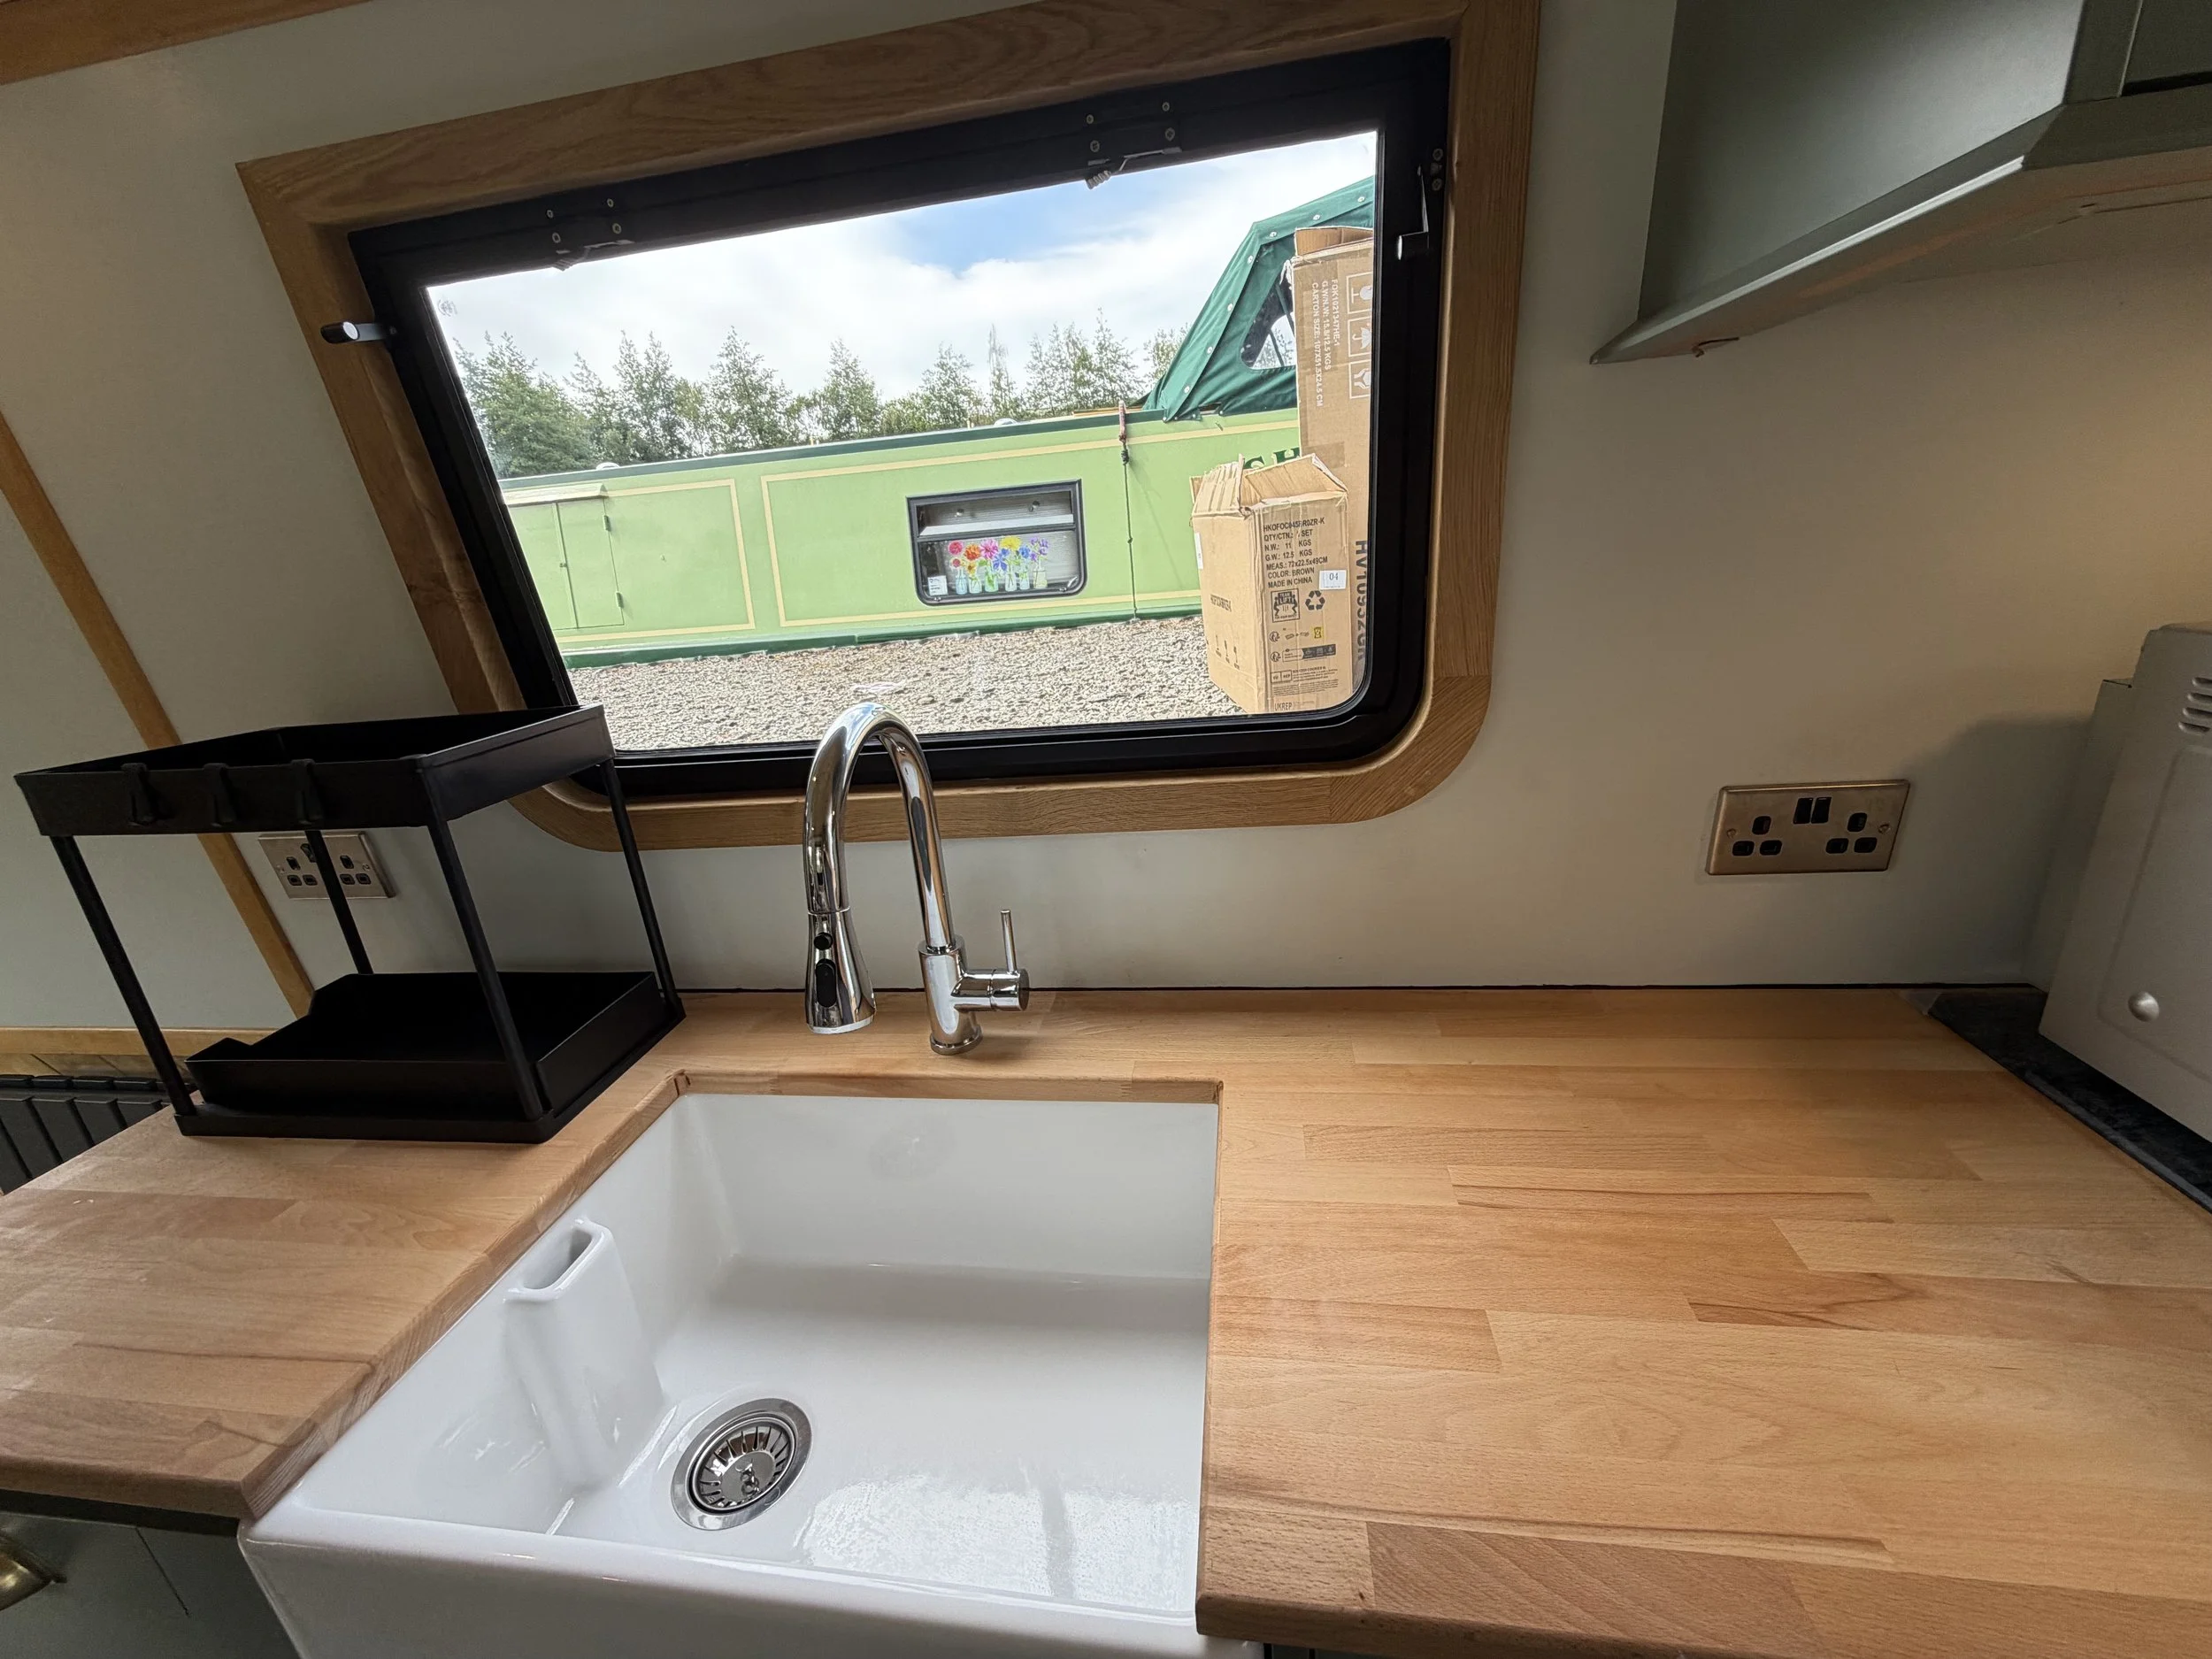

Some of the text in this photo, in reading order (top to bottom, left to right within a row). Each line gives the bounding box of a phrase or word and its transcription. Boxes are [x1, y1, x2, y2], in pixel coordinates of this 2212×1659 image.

[1316, 394, 1324, 407] CM
[1298, 539, 1312, 548] KGS
[1283, 550, 1294, 559] 12.5
[1292, 566, 1315, 576] BROWN
[1267, 579, 1286, 588] MADE
[1294, 576, 1313, 585] CHINA
